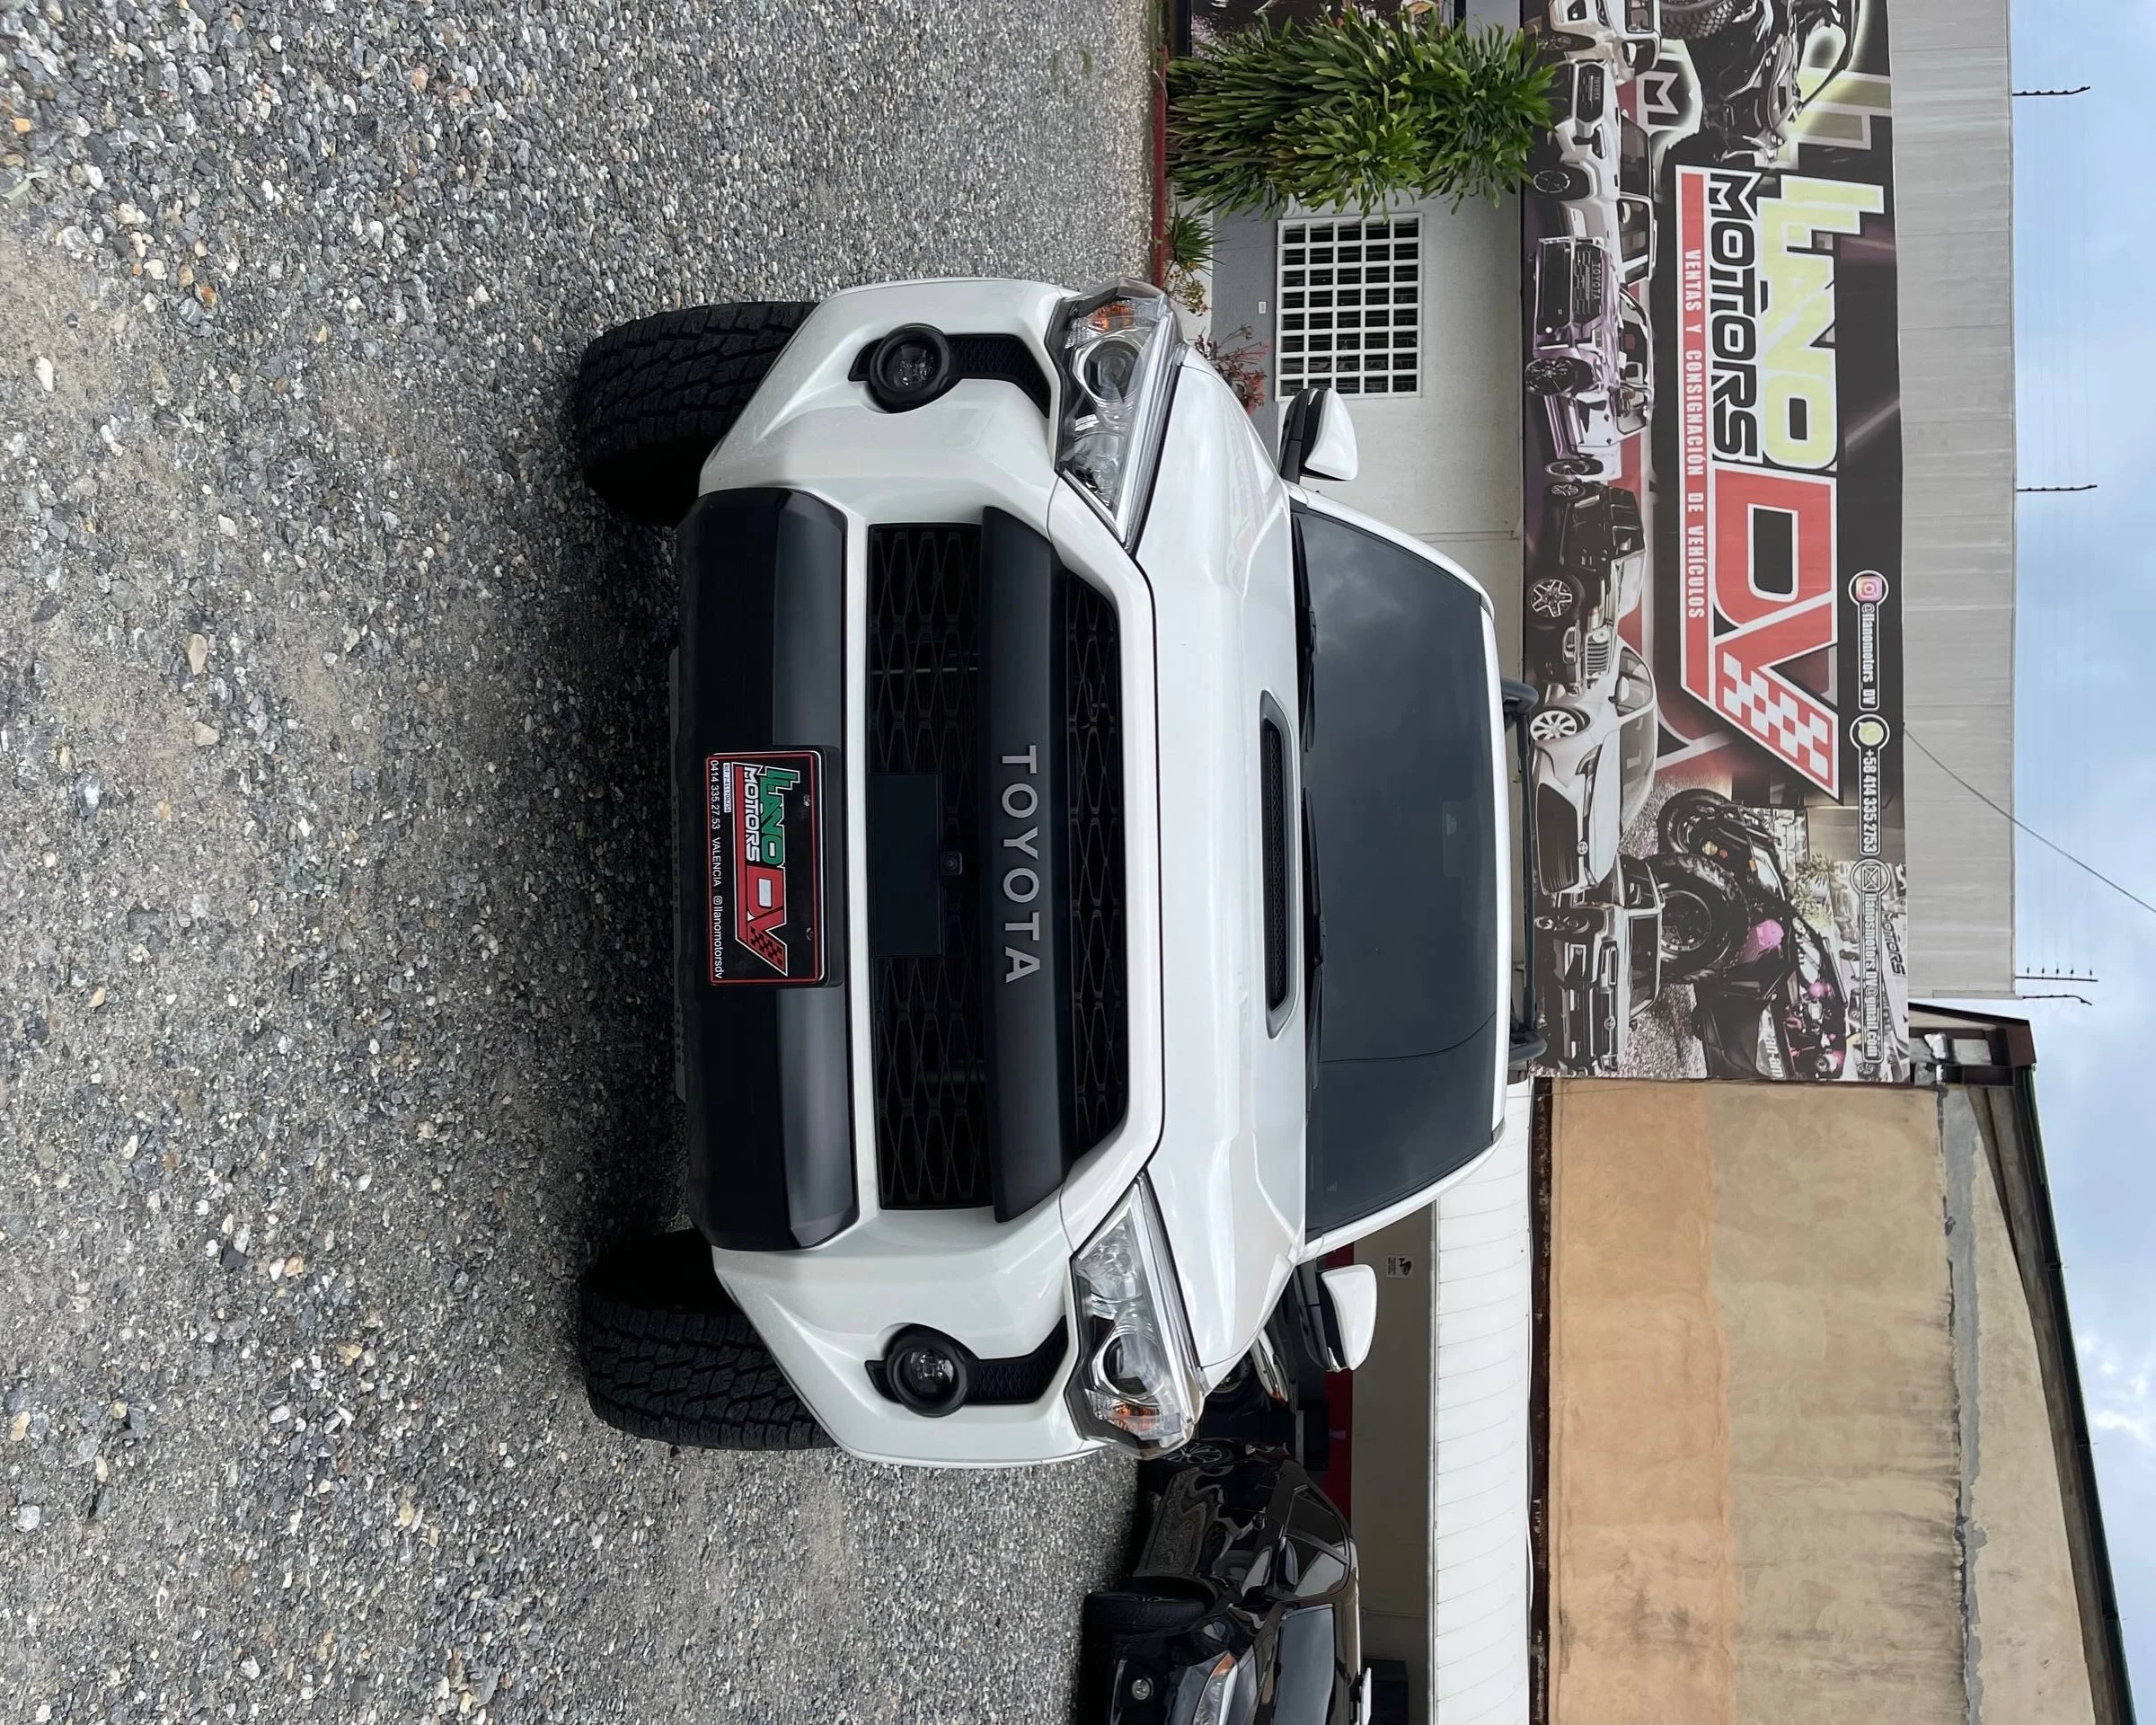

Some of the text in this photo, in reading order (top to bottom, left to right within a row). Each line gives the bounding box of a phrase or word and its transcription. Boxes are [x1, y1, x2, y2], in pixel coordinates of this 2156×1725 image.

[1591, 262, 1602, 300] TOYOTA
[1710, 175, 1758, 460] MOTORS
[1685, 249, 1709, 618] VENTAS Y CONSIGNACIÓN DE VEHÍCULOS
[1712, 465, 1837, 798] DV
[1860, 603, 1876, 705] @llanomotors_DV
[744, 766, 762, 862] MOTORS
[1863, 749, 1878, 853] +58 414 335 2753
[711, 760, 723, 979] 0414 335.27.53 VALENCIA llanomotorsdv
[1002, 745, 1040, 984] TOYOTA
[746, 865, 788, 977] DV
[1882, 911, 1906, 975] MOTORS
